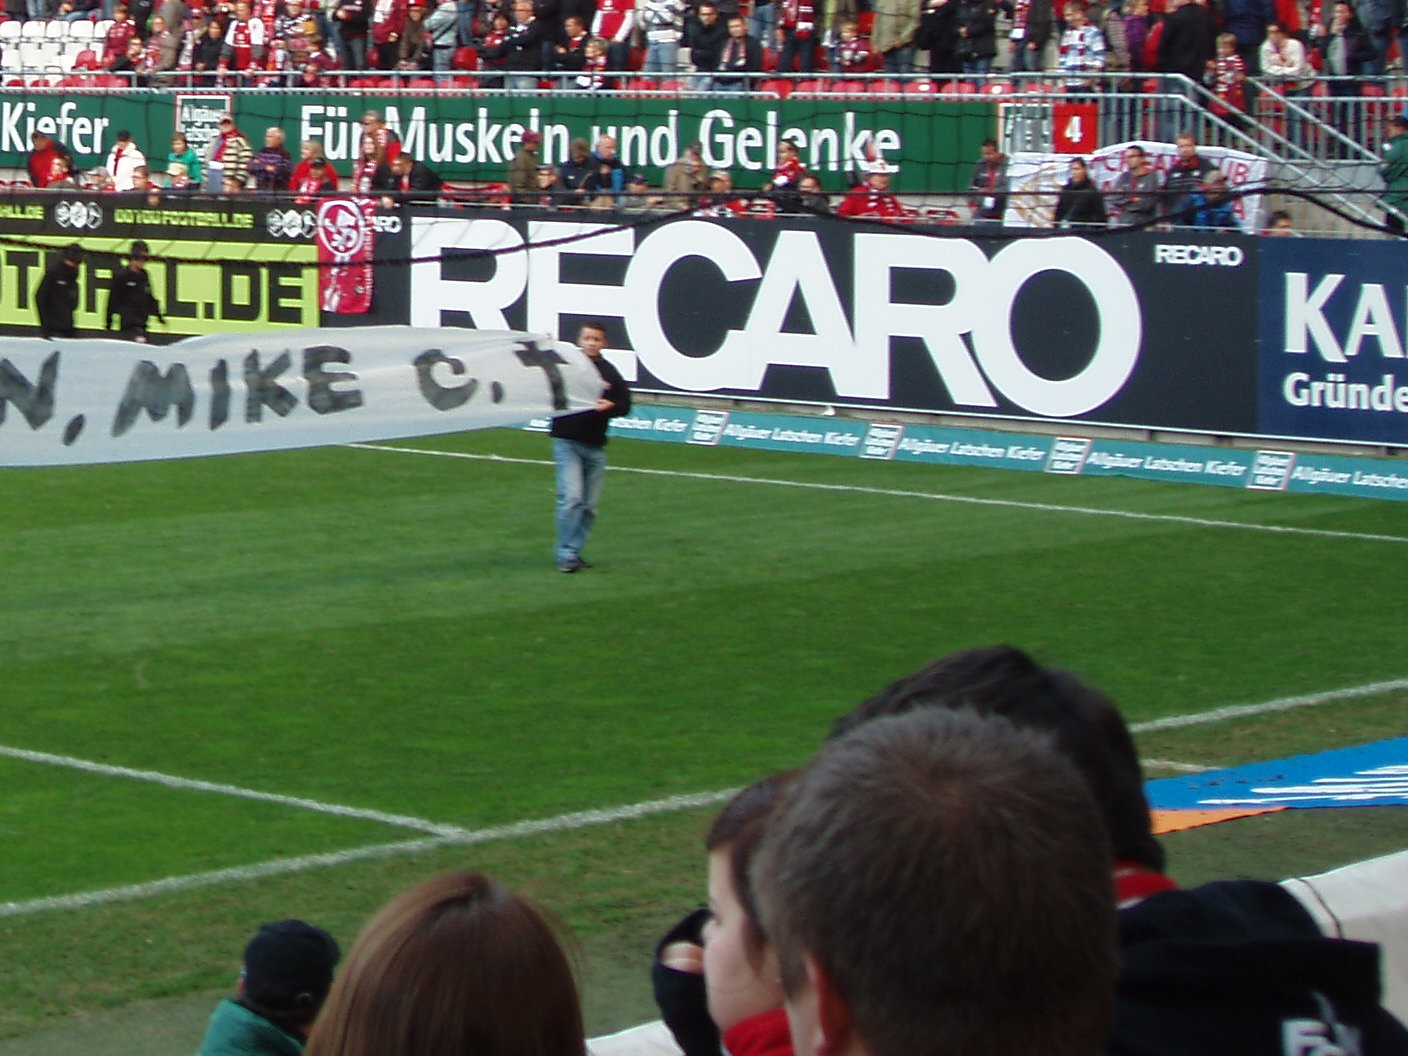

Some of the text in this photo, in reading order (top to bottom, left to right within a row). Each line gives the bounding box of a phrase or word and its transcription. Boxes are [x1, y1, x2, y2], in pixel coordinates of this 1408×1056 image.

[0, 101, 110, 154] Kiefer
[1063, 115, 1084, 143] 4
[1154, 244, 1244, 267] RECARO
[410, 215, 1143, 418] RECARO
[1284, 272, 1408, 363] KA
[110, 343, 364, 437] MIKE
